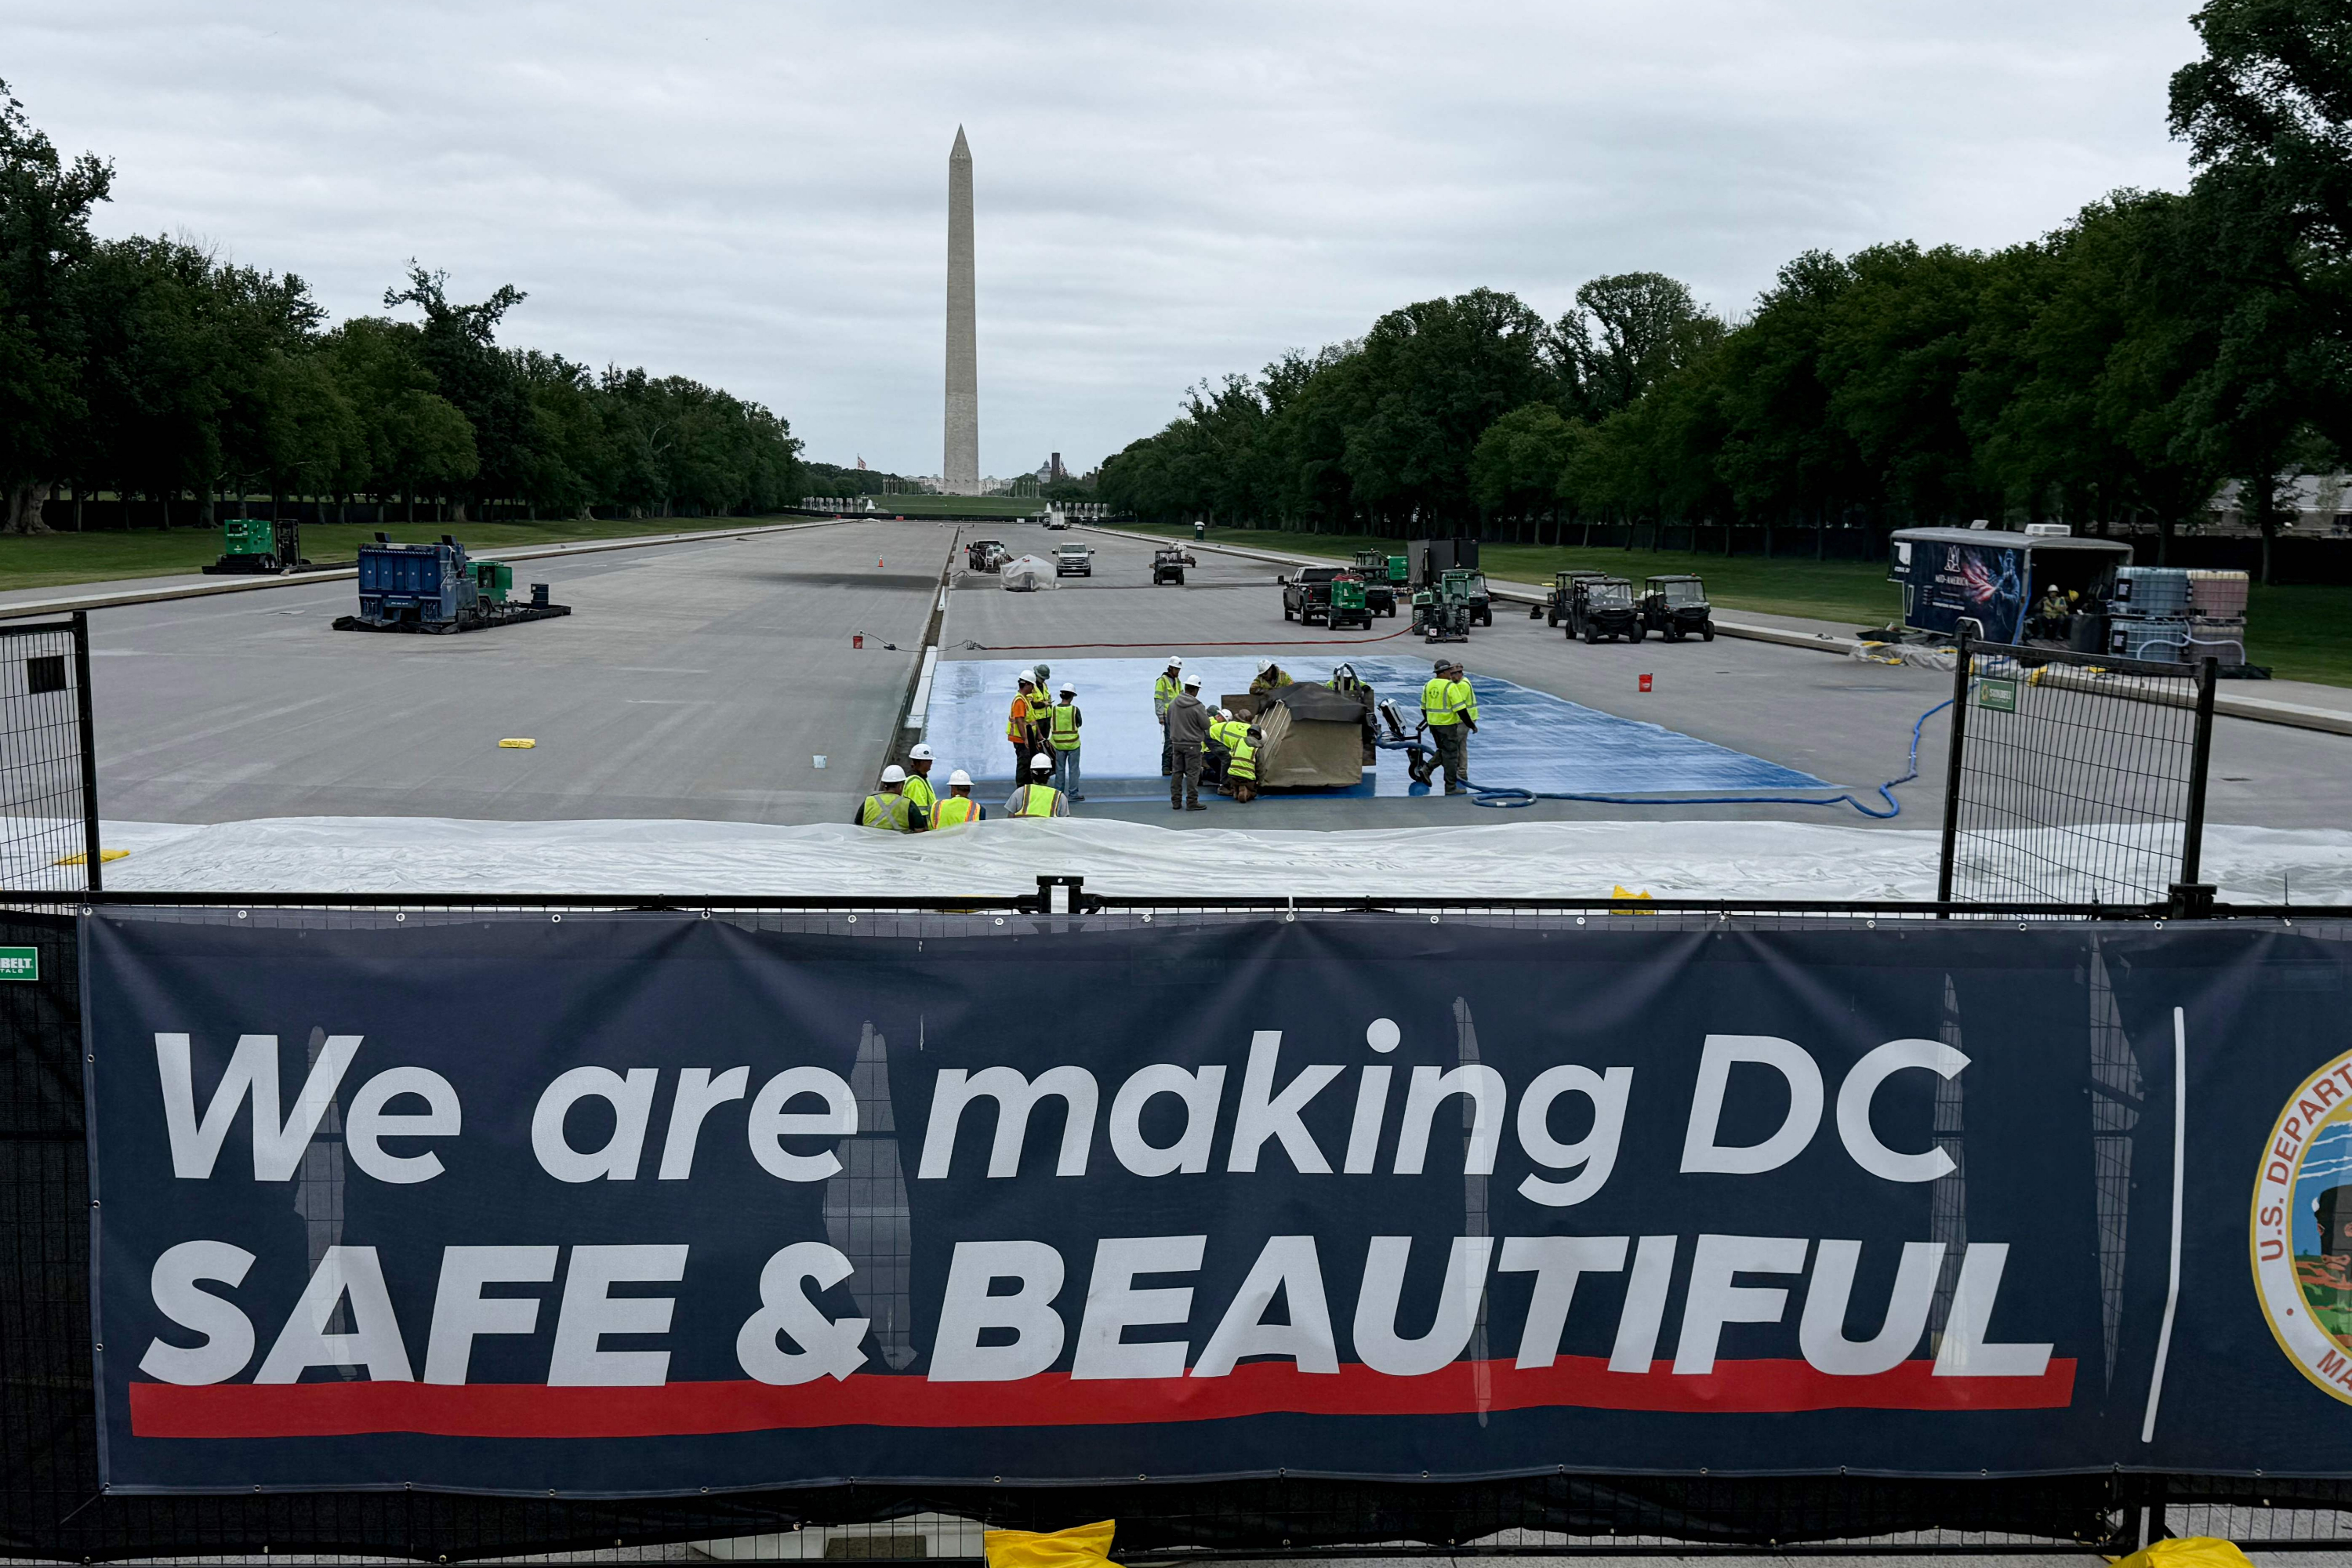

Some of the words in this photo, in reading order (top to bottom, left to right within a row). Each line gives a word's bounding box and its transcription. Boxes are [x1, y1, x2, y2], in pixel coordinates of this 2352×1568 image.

[154, 1033, 462, 1183] We
[531, 1065, 858, 1182] are
[918, 1018, 1634, 1207] making
[1680, 1034, 1972, 1182] DC
[2266, 1062, 2352, 1185] DEPART
[2260, 1197, 2285, 1261] U.S.
[138, 1240, 690, 1386] SAFE
[737, 1241, 870, 1385] &
[927, 1234, 2054, 1382] BEAUTIFUL
